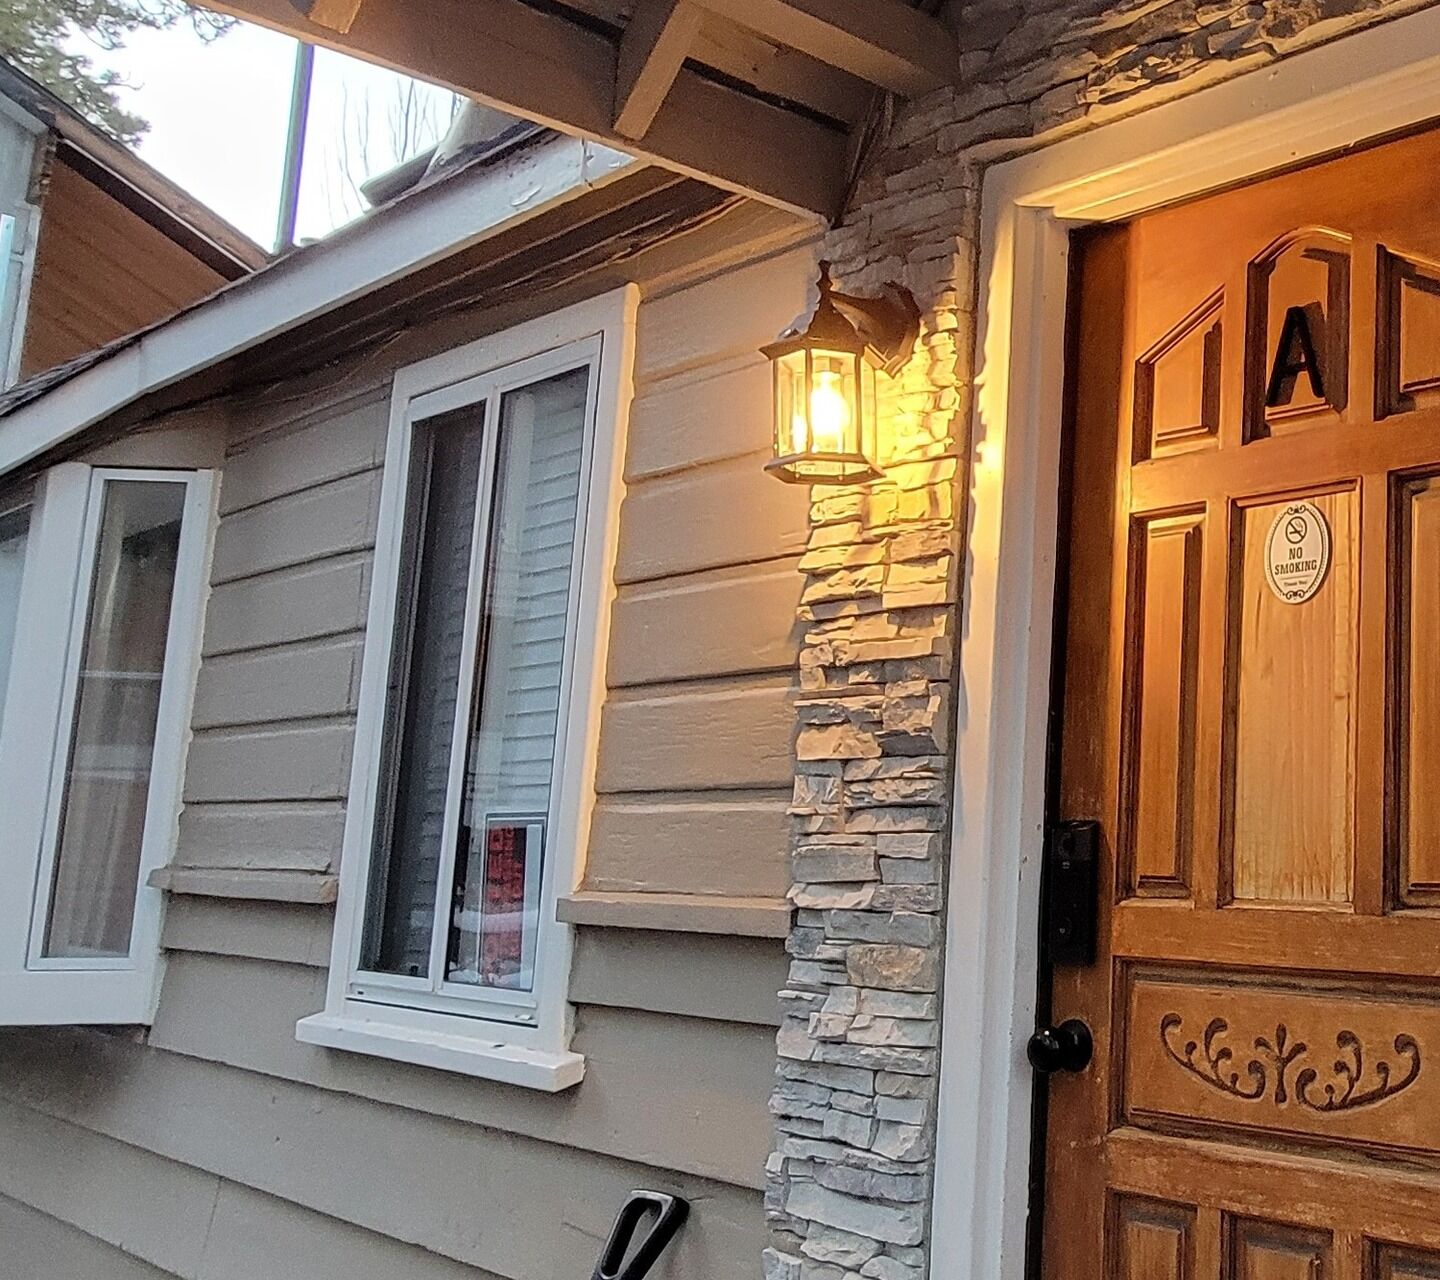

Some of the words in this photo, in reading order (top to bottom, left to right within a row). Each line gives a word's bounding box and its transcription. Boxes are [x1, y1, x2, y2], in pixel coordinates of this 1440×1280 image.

[1266, 305, 1327, 407] A
[1288, 547, 1303, 560] NO
[1274, 559, 1317, 575] SMOKING
